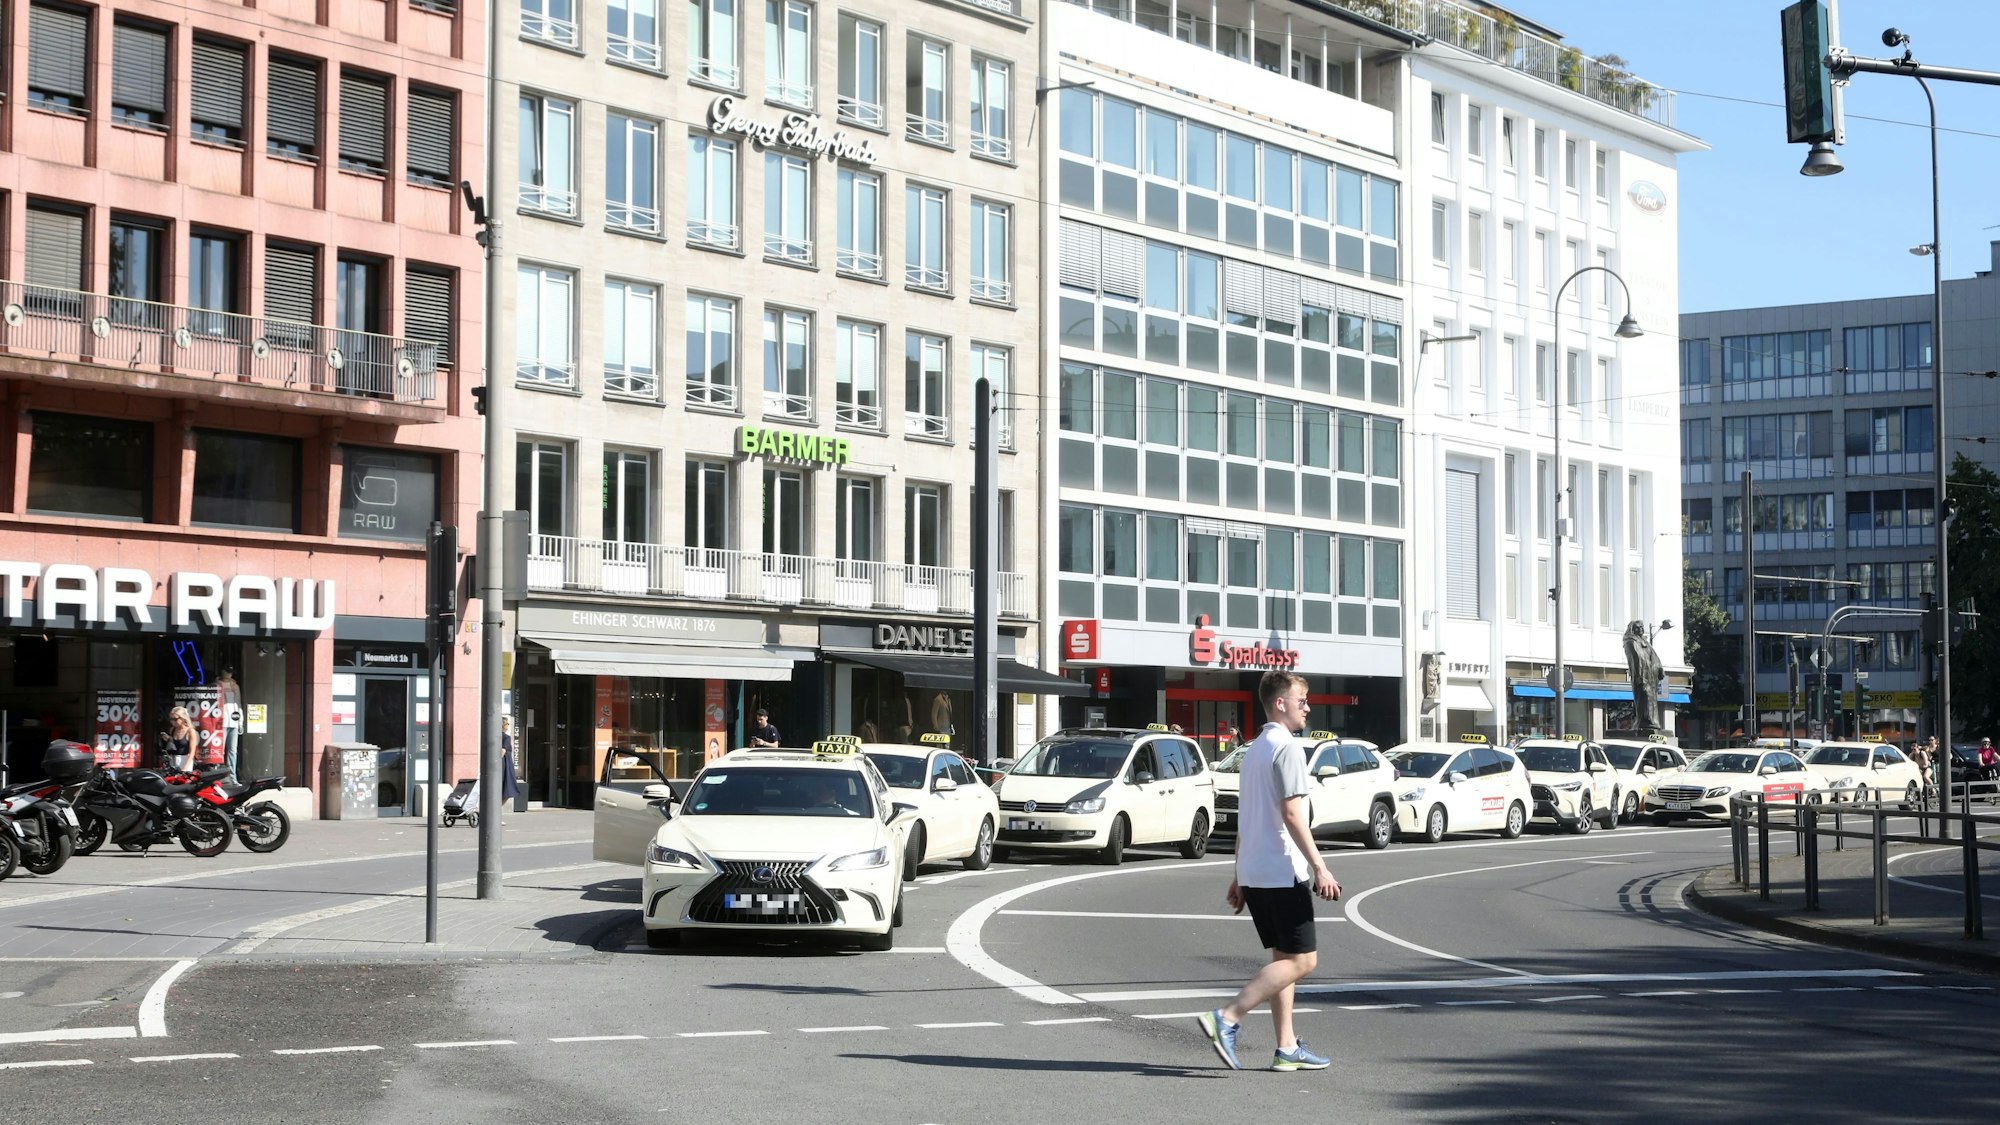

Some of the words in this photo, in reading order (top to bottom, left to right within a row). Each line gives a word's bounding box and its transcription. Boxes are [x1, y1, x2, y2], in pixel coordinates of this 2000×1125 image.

[712, 94, 778, 147] Georg
[781, 113, 880, 164] Fahrbach
[1628, 398, 1670, 418] LEMPERTZ
[741, 425, 851, 465] BARMER
[353, 513, 396, 529] RAW
[0, 560, 153, 623] TAR
[172, 571, 335, 631] RAW
[572, 611, 627, 627] EHINGER
[631, 615, 688, 631] SCHWARZ
[692, 618, 716, 632] 1876
[878, 624, 975, 649] DANIELS
[364, 653, 398, 663] Neumarkt
[399, 654, 409, 663] 1b
[1222, 640, 1300, 669] Sparkasse
[174, 692, 222, 700] AUSVERKAUF
[96, 704, 140, 722] 30%
[96, 734, 140, 752] 50%
[831, 736, 855, 745] TAXI
[924, 734, 946, 742] TAXI
[819, 743, 848, 754] TAXI
